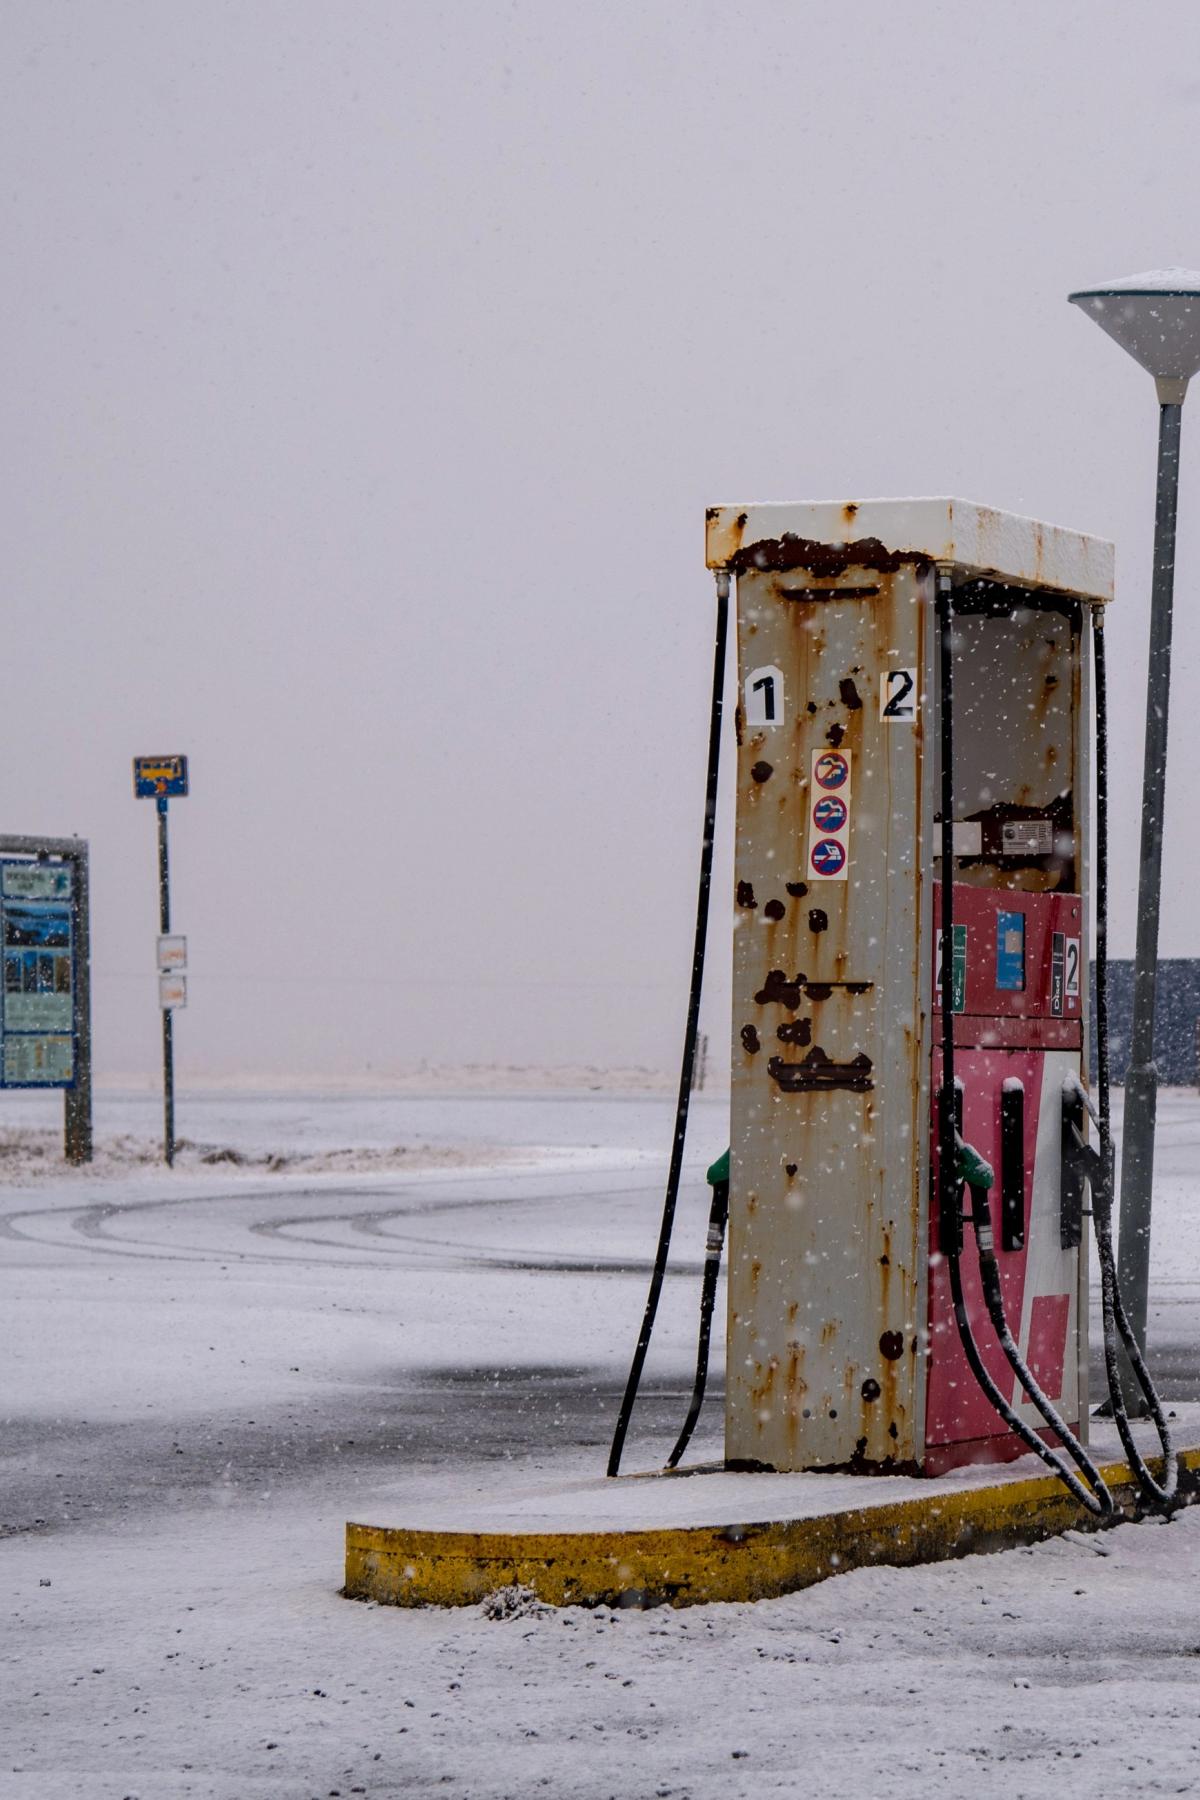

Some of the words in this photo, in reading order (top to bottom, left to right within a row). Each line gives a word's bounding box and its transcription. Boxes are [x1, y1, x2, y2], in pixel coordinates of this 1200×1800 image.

[752, 675, 775, 720] 1
[882, 671, 914, 716] 2
[1067, 944, 1078, 990] 2
